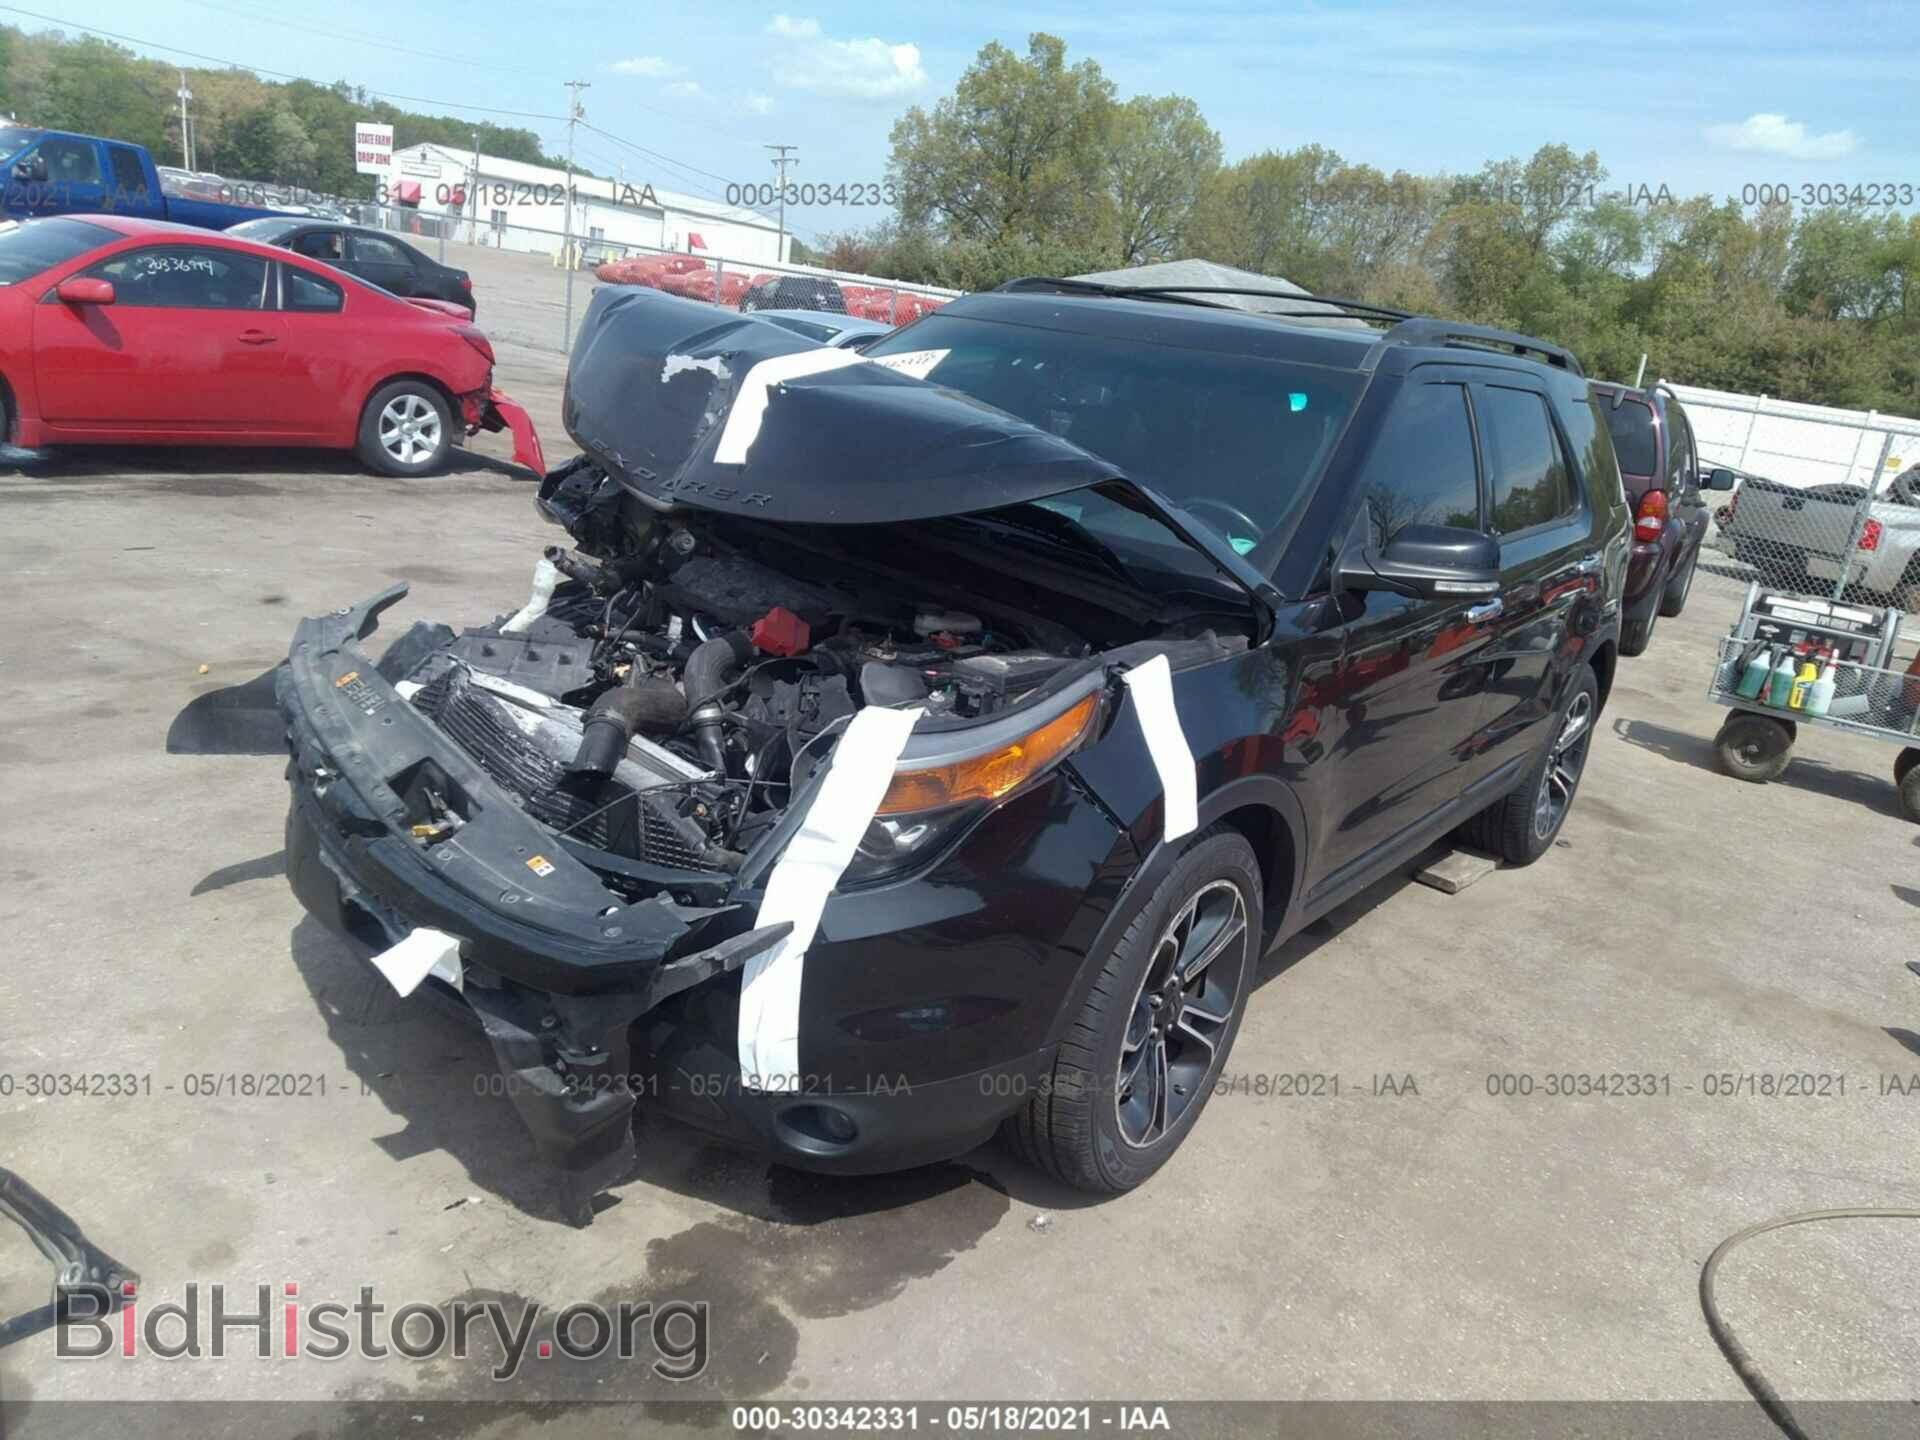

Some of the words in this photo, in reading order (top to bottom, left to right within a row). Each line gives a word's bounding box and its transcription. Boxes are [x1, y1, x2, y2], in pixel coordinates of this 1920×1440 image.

[357, 132, 375, 144] STATE
[375, 134, 391, 145] FARM
[357, 151, 374, 163] DROP
[375, 152, 391, 166] ZONE
